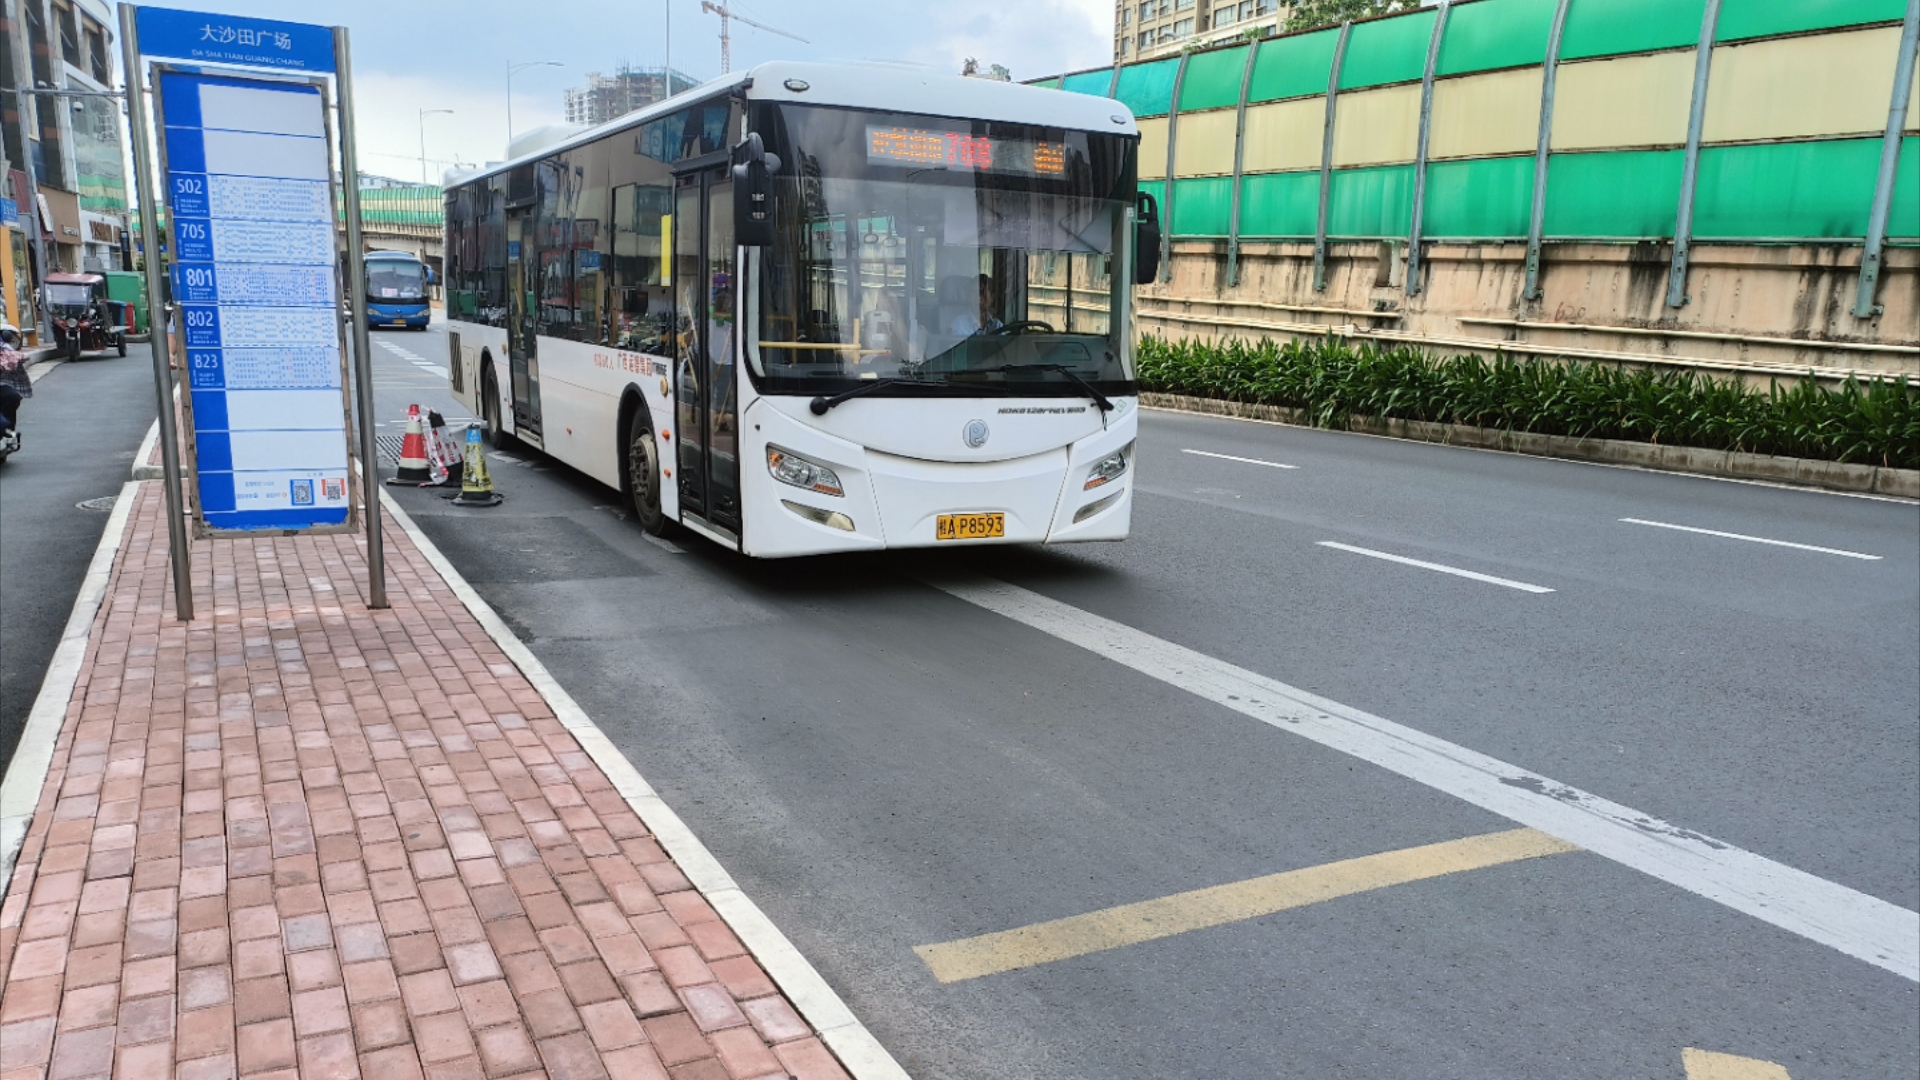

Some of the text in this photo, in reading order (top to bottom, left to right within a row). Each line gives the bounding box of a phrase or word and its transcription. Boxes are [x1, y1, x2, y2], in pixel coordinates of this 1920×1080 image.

[199, 23, 292, 50] 大沙田广场
[191, 49, 305, 67] DA SHA TIAN GUANG CHANG
[177, 178, 203, 195] 502
[180, 223, 206, 240] 705
[186, 268, 214, 287] 801
[187, 310, 214, 327] 802
[195, 354, 218, 369] B23
